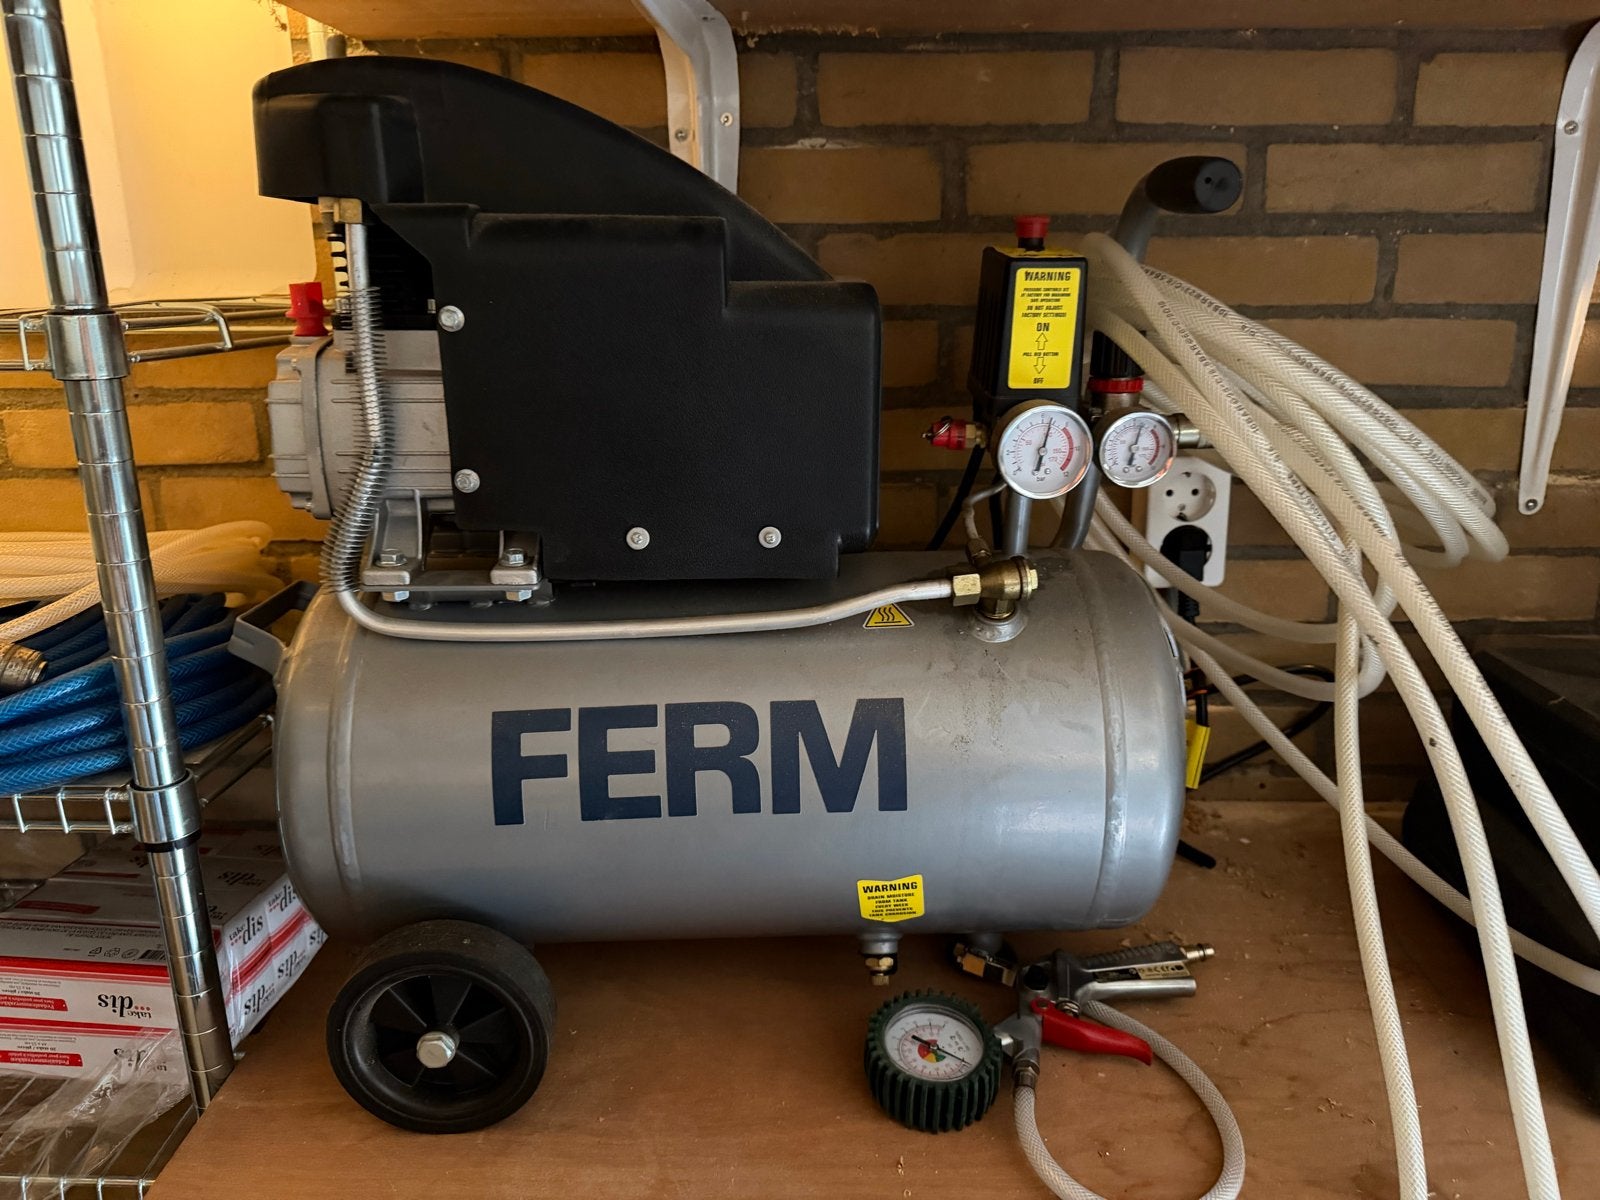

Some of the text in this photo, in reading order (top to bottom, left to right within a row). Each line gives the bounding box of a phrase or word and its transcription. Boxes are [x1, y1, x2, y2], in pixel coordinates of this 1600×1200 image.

[1024, 271, 1072, 282] WARNING
[1036, 322, 1050, 332] ON
[491, 697, 908, 826] FERM
[862, 881, 918, 894] WARNING
[229, 915, 264, 945] take dis
[277, 950, 298, 979] dis
[97, 993, 152, 1019] take dis
[243, 984, 265, 1016] dis
